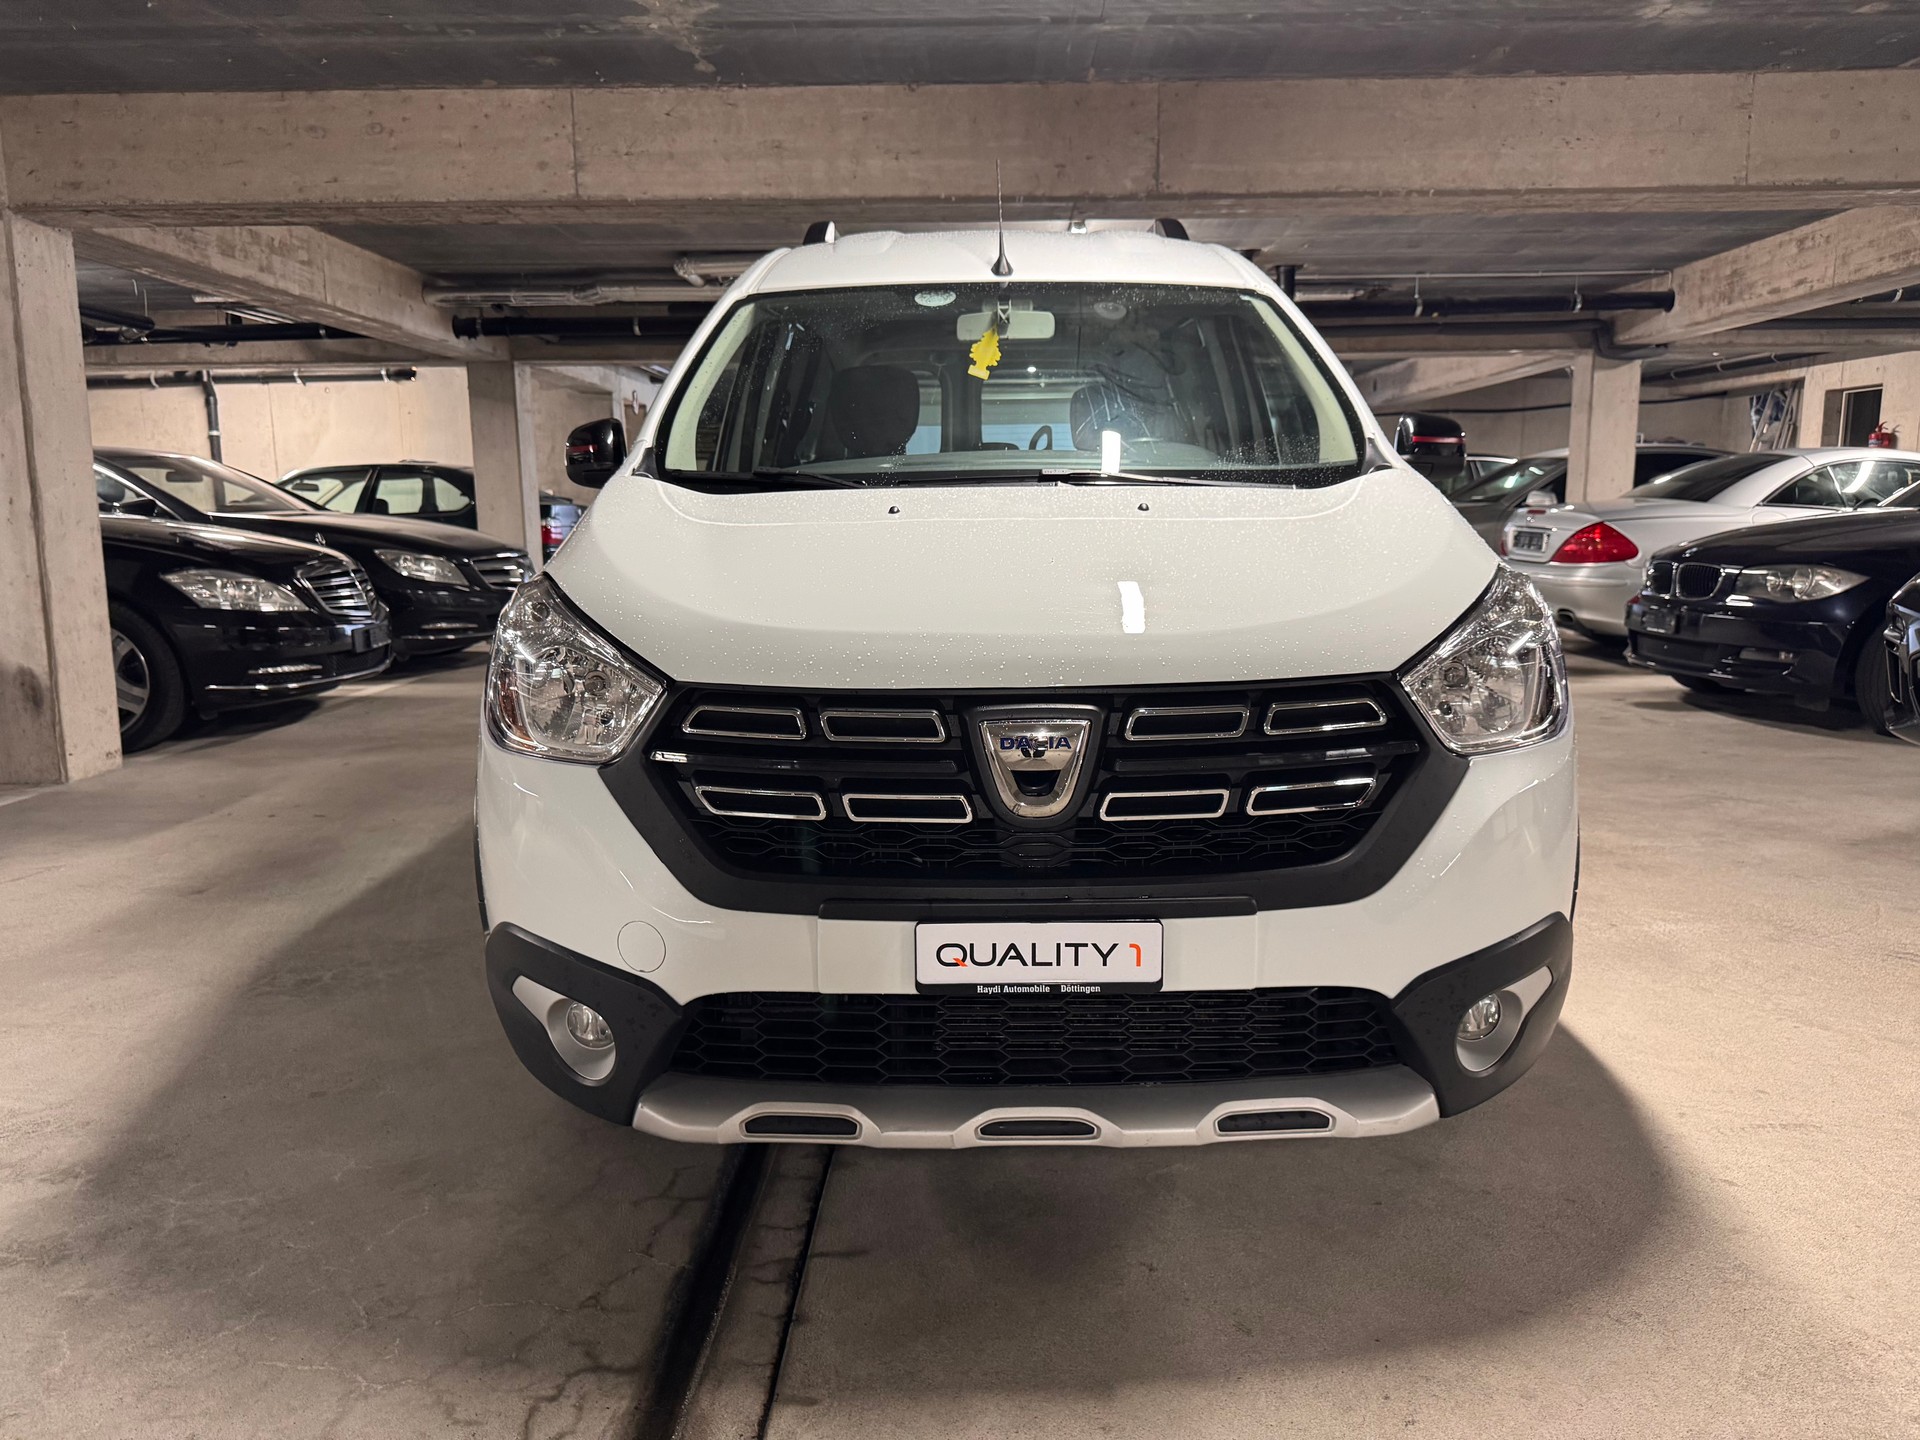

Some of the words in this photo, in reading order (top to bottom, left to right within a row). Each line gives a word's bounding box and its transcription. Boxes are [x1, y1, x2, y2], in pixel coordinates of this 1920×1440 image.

[936, 942, 1119, 967] QUALITY
[1129, 943, 1142, 967] 1
[977, 985, 1001, 995] Haydi
[1003, 985, 1051, 993] Automobile
[1061, 984, 1101, 994] Döttingen
